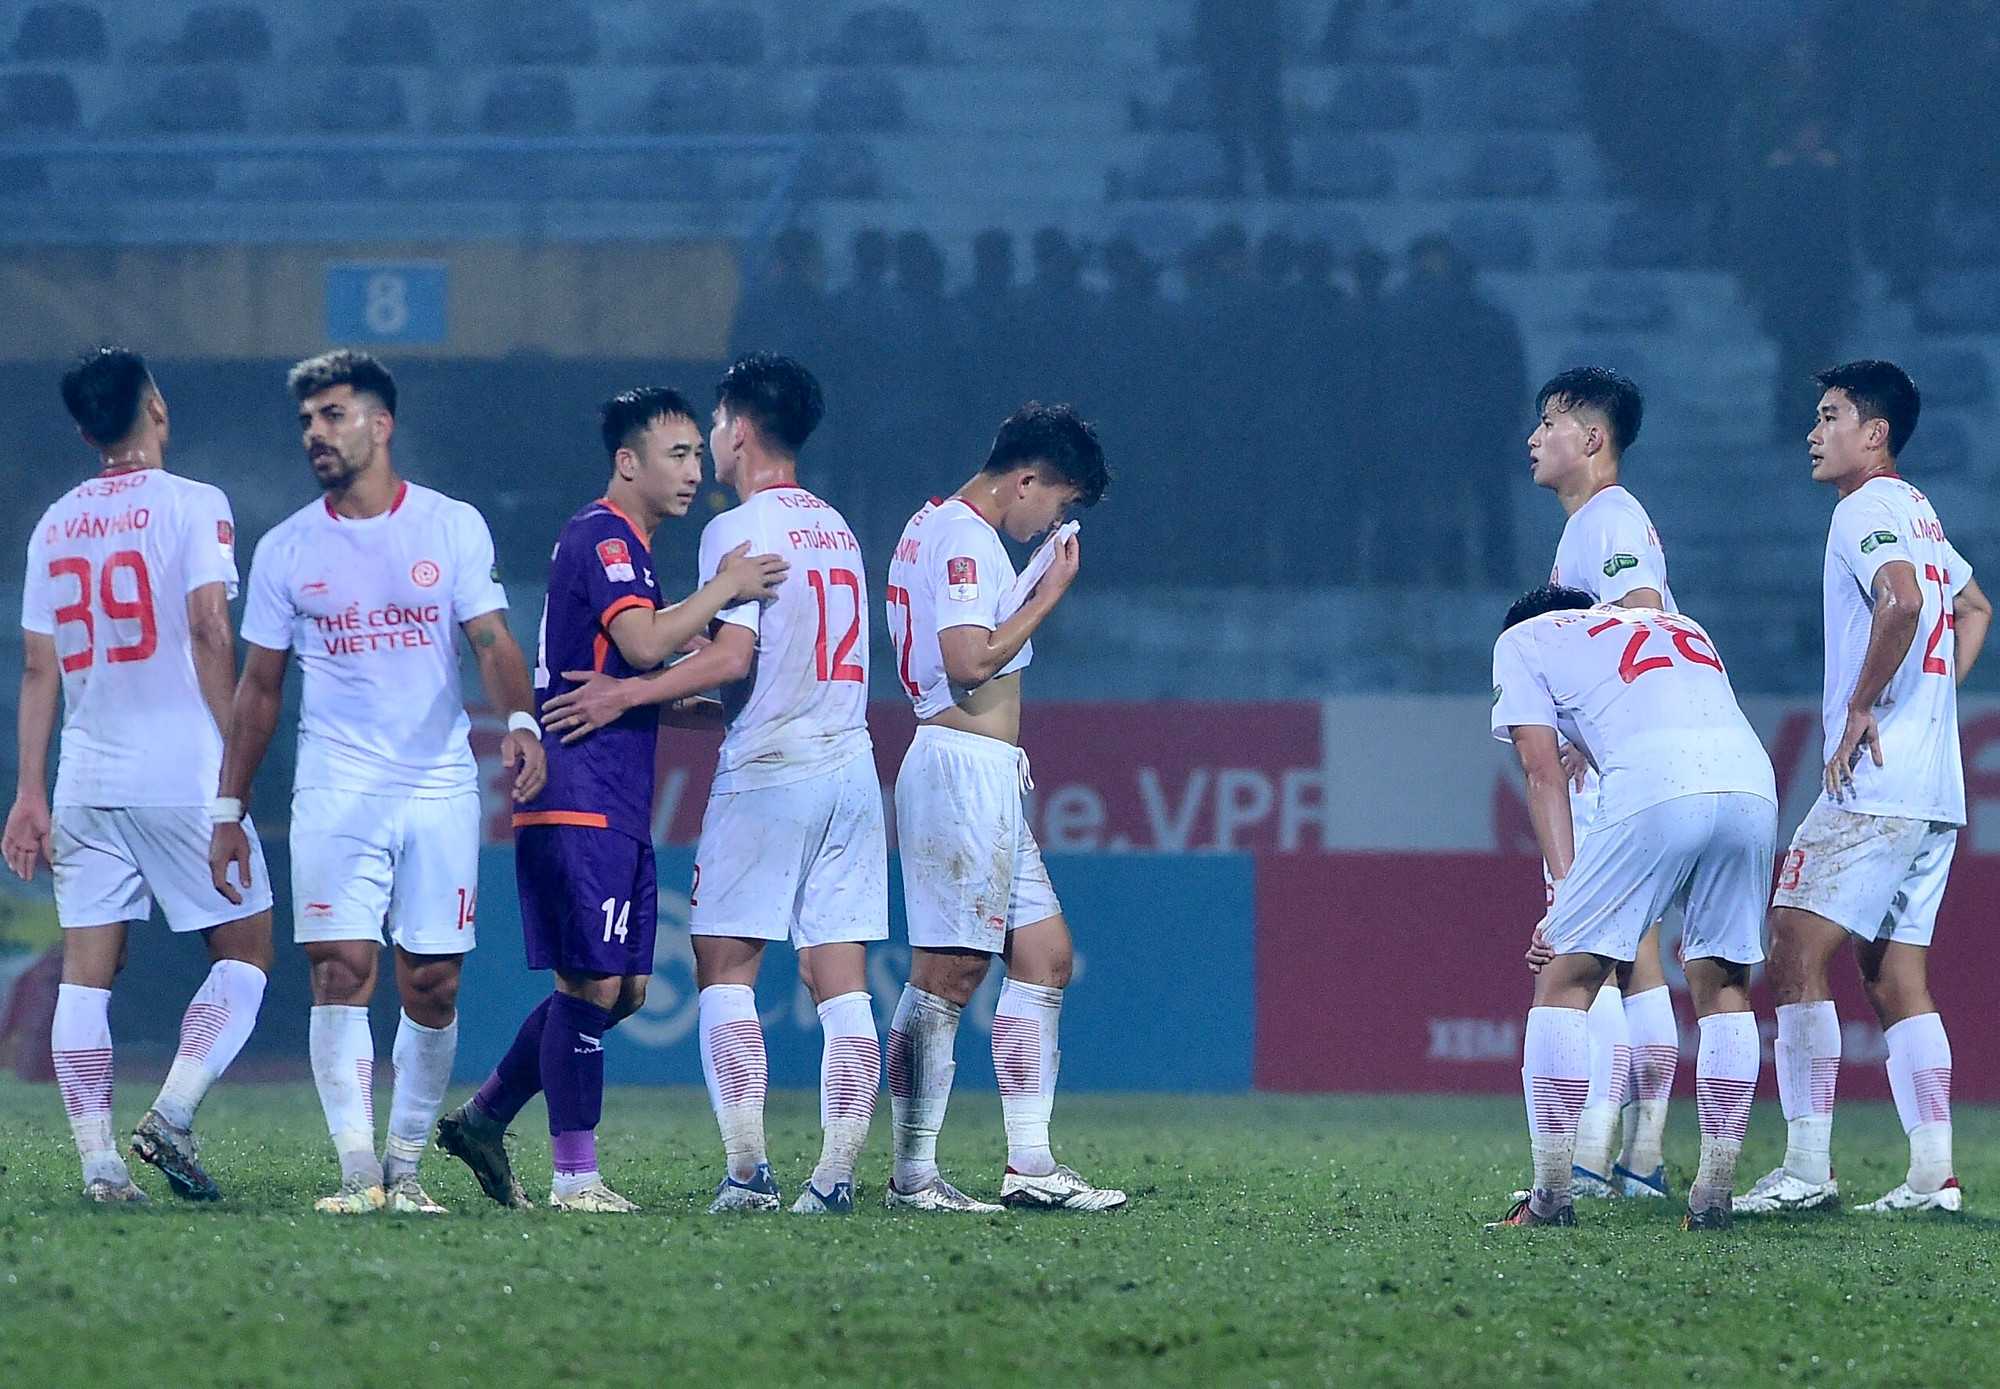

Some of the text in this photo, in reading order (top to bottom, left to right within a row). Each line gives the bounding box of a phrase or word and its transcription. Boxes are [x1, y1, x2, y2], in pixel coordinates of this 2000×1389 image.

[366, 274, 408, 332] 8
[48, 550, 158, 673] 39
[368, 603, 439, 627] CÔNG
[807, 567, 864, 685] 12
[324, 628, 432, 656] VIETTEL
[601, 897, 631, 944] 14
